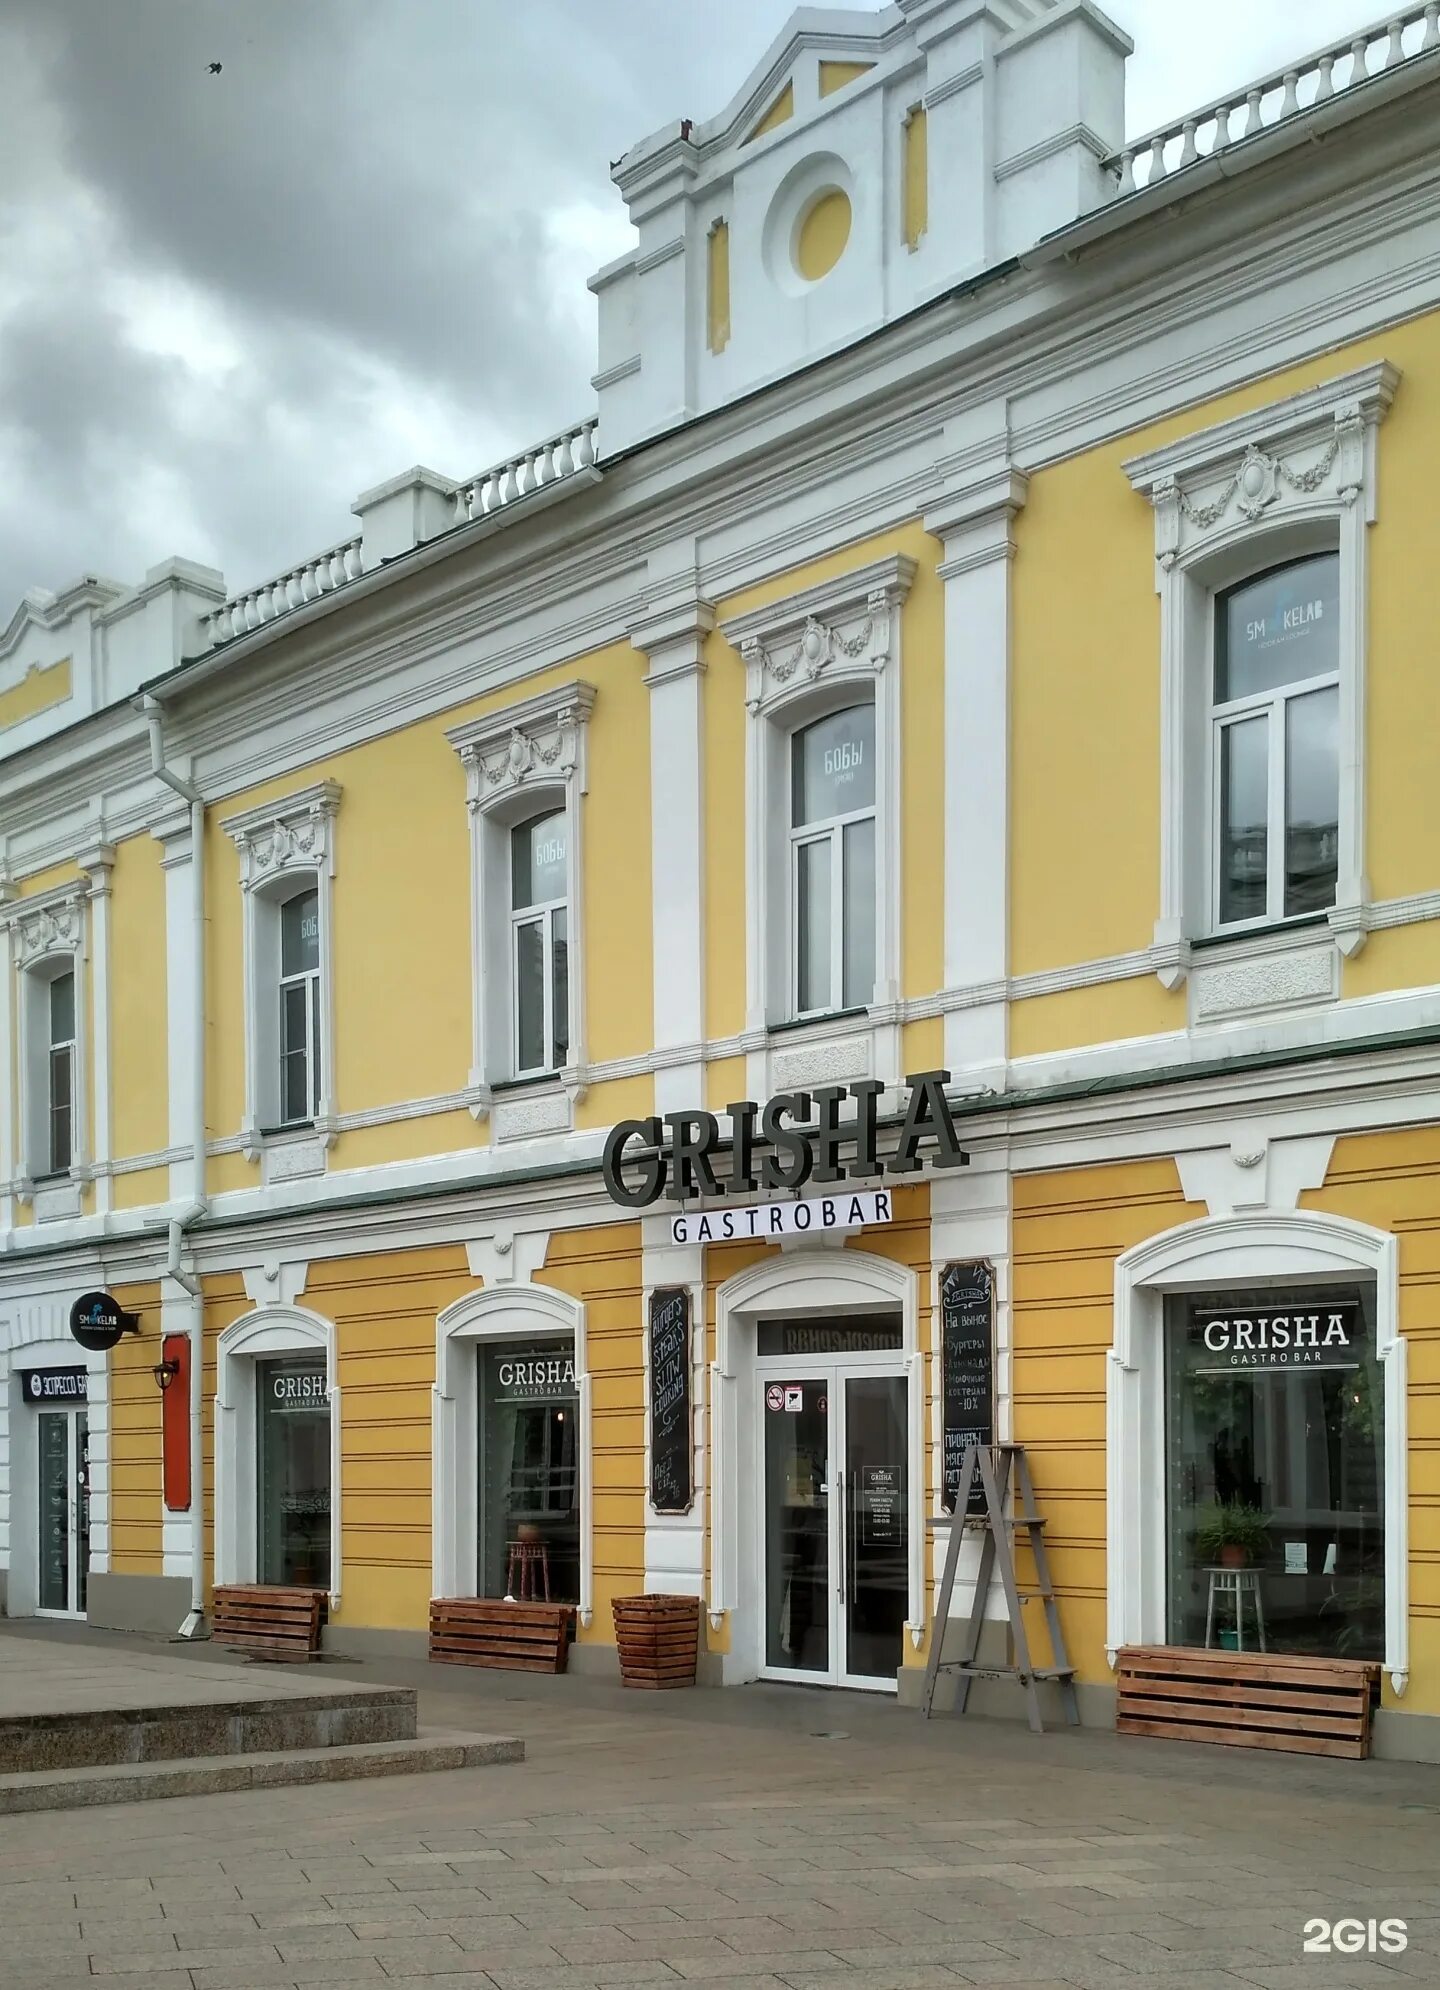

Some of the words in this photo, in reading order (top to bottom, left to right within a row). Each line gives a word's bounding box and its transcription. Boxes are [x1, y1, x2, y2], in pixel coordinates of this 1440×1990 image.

[824, 740, 863, 775] БОБЫ
[301, 916, 318, 939] БОБ
[602, 1069, 970, 1208] GRISHA
[673, 1193, 890, 1243] GASTROBAR
[945, 1312, 958, 1328] На
[961, 1314, 988, 1327] вынос
[1204, 1314, 1350, 1351] GRISHA
[500, 1360, 576, 1385] GRISHA
[43, 1376, 76, 1395] ЭСПРЕССО
[958, 1397, 978, 1410] -10%
